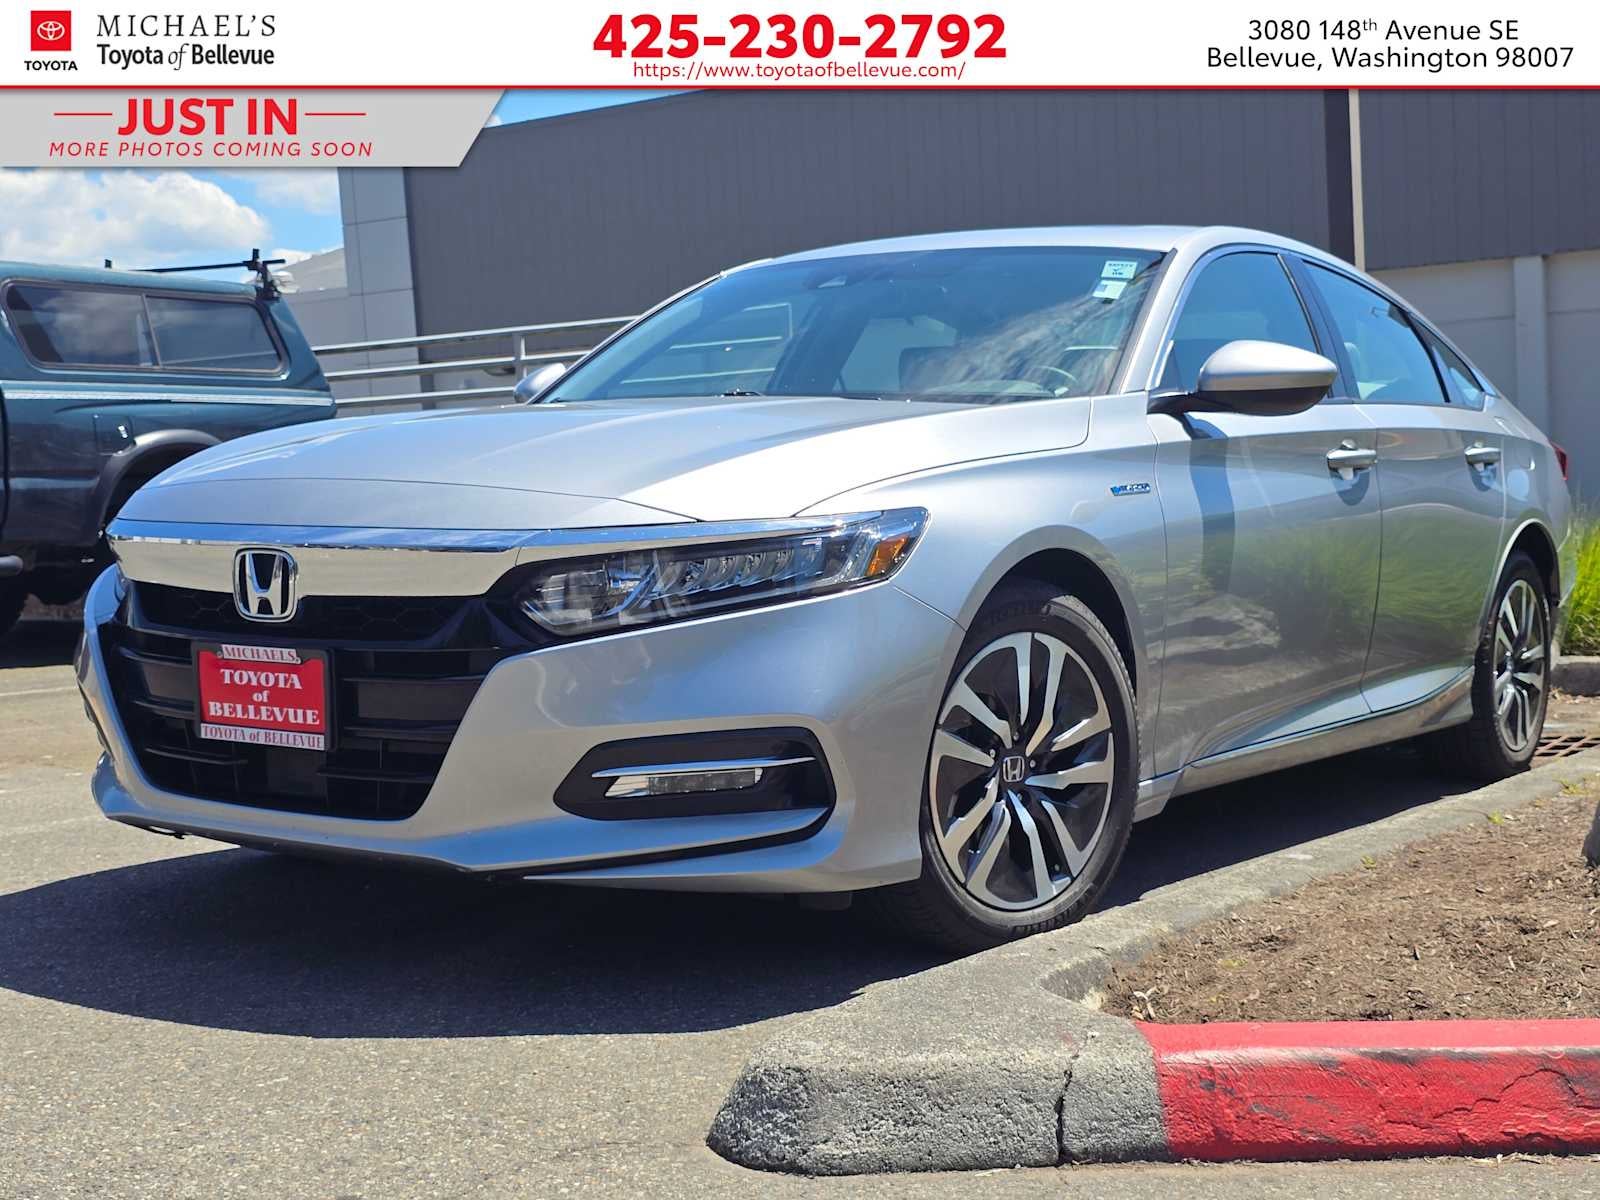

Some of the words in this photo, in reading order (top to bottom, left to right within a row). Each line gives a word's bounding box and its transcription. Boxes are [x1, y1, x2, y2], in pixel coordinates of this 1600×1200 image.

[220, 668, 302, 690] TOYOTA
[252, 690, 271, 703] of
[208, 701, 320, 725] BELLEVUE
[202, 725, 246, 741] TOYOTA
[249, 729, 261, 743] of
[264, 731, 322, 749] BELLEVUE
